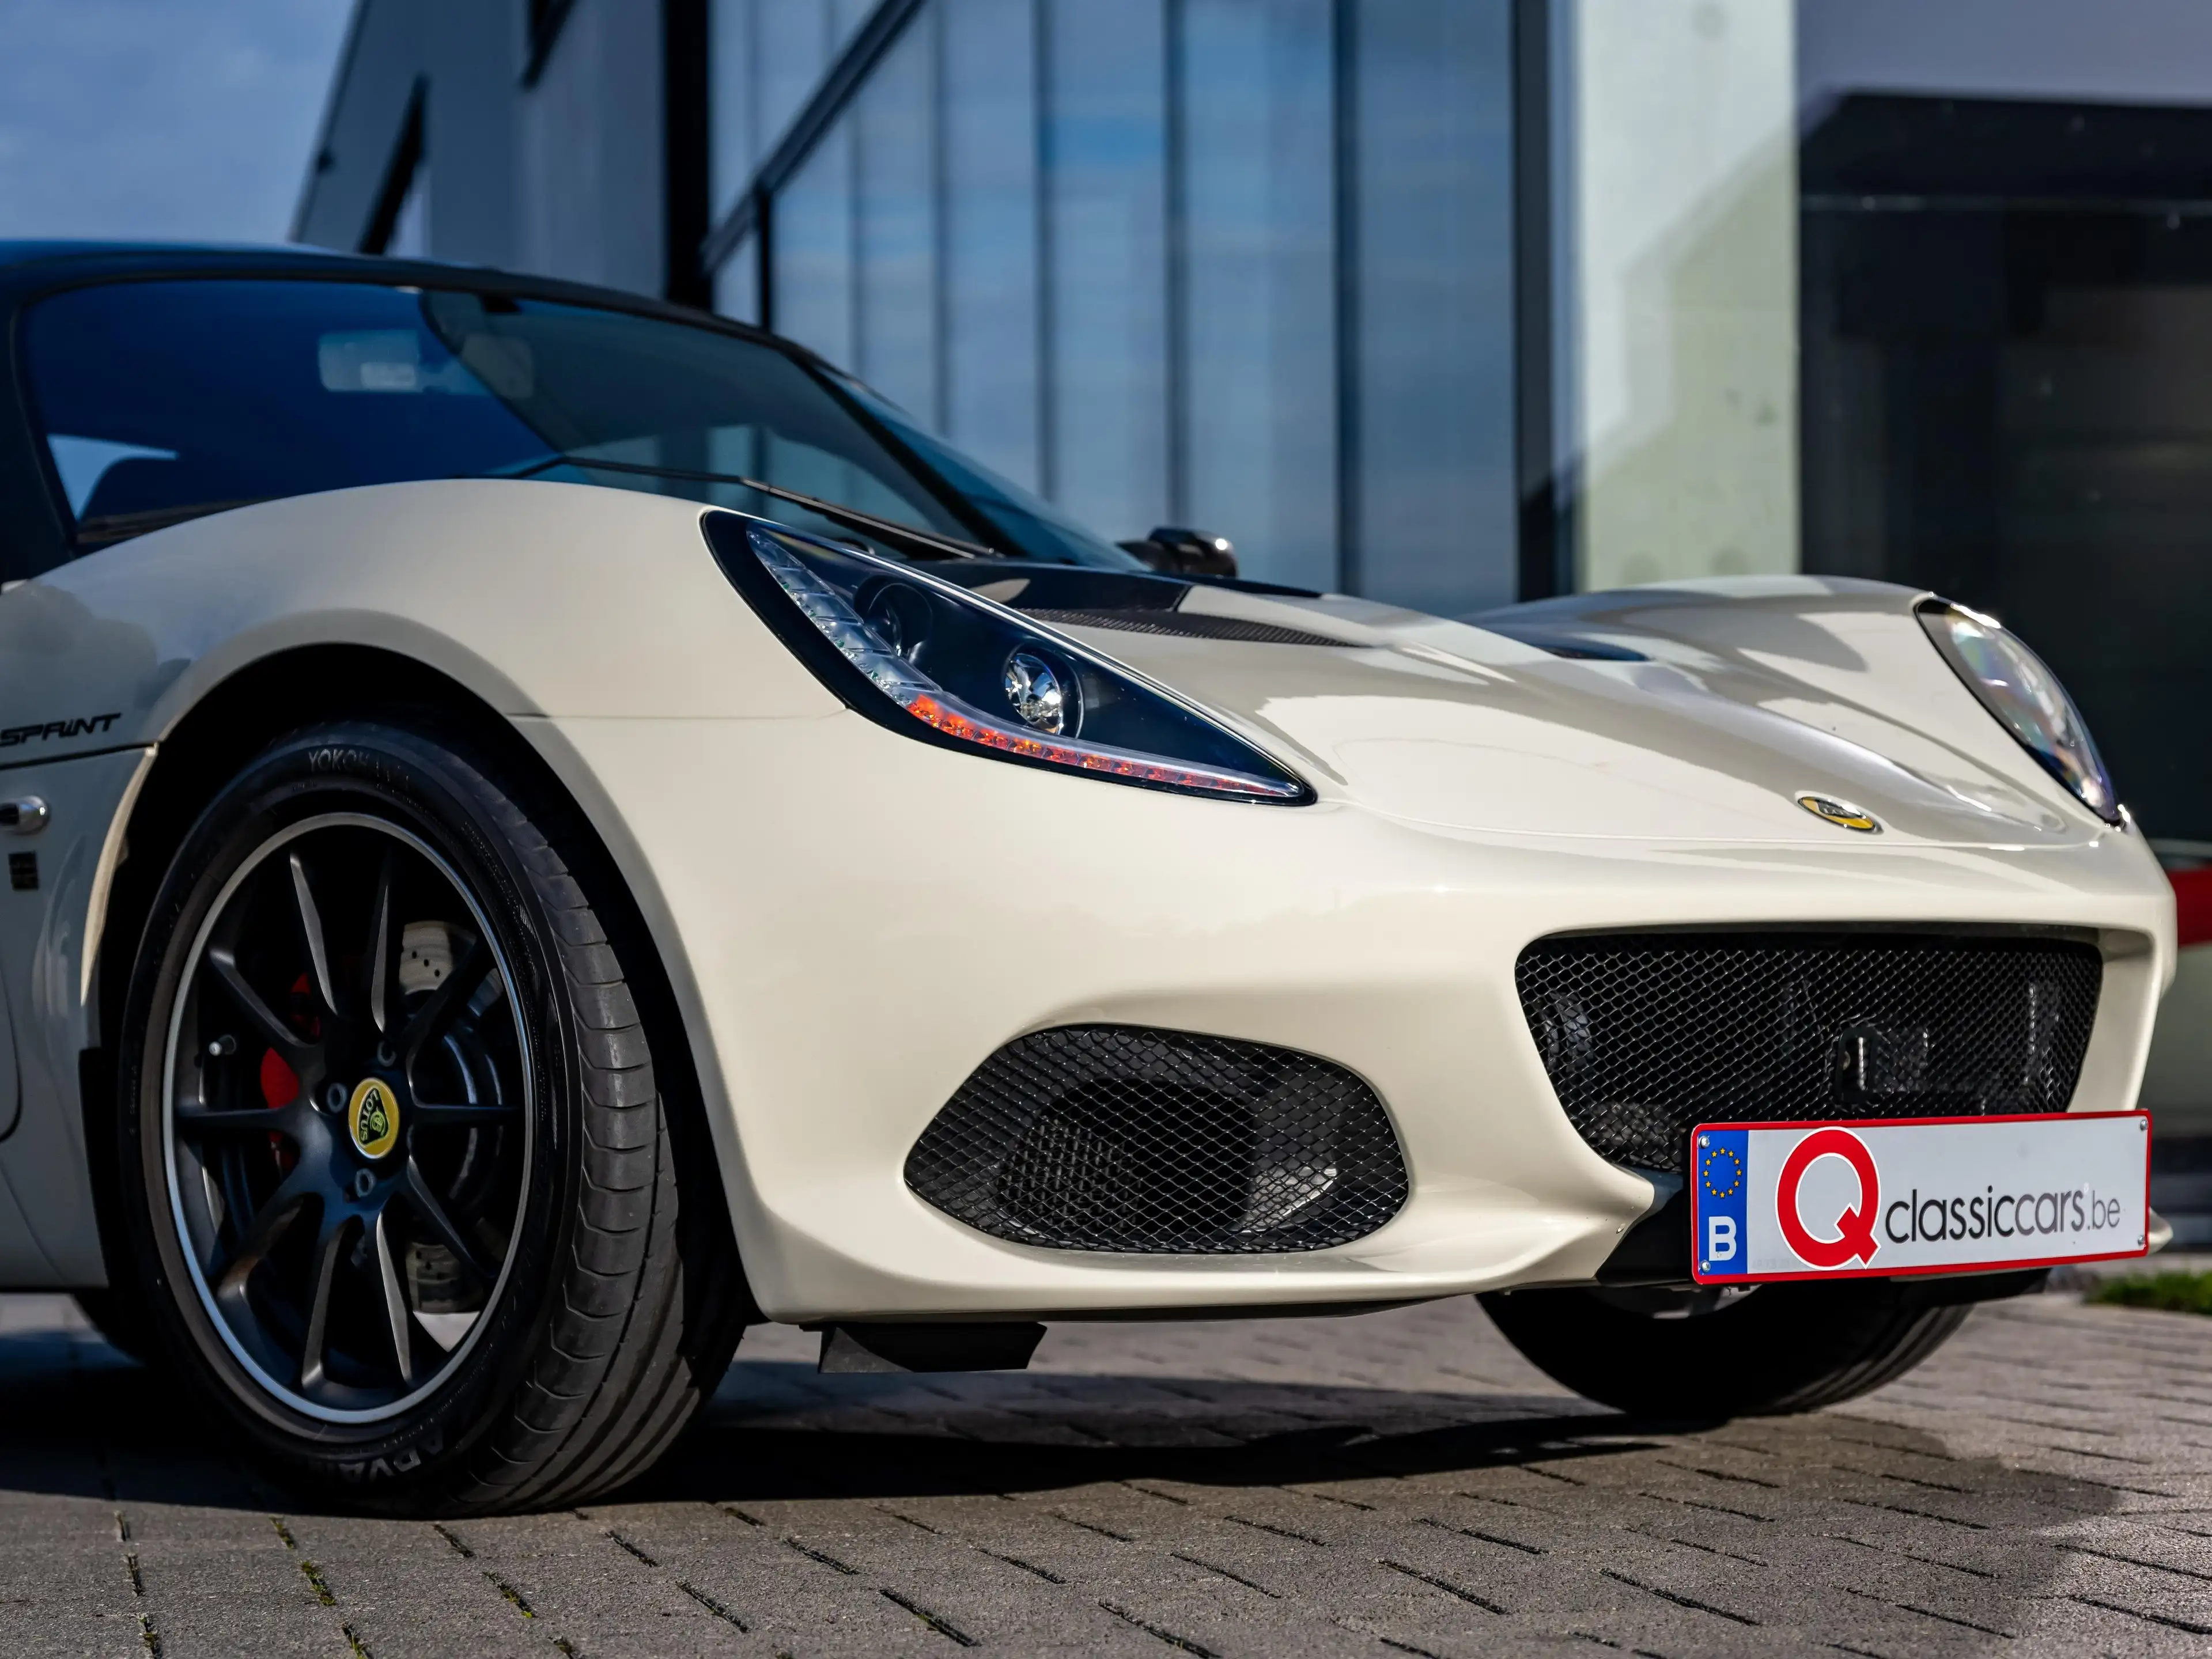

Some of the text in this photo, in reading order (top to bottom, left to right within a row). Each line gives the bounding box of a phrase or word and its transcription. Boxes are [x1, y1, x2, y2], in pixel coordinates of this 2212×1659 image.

[0, 712, 122, 747] SPRINT
[360, 1088, 380, 1142] LOTUS
[1776, 1127, 2120, 1269] Q classiccars.be
[1708, 1215, 1737, 1262] B
